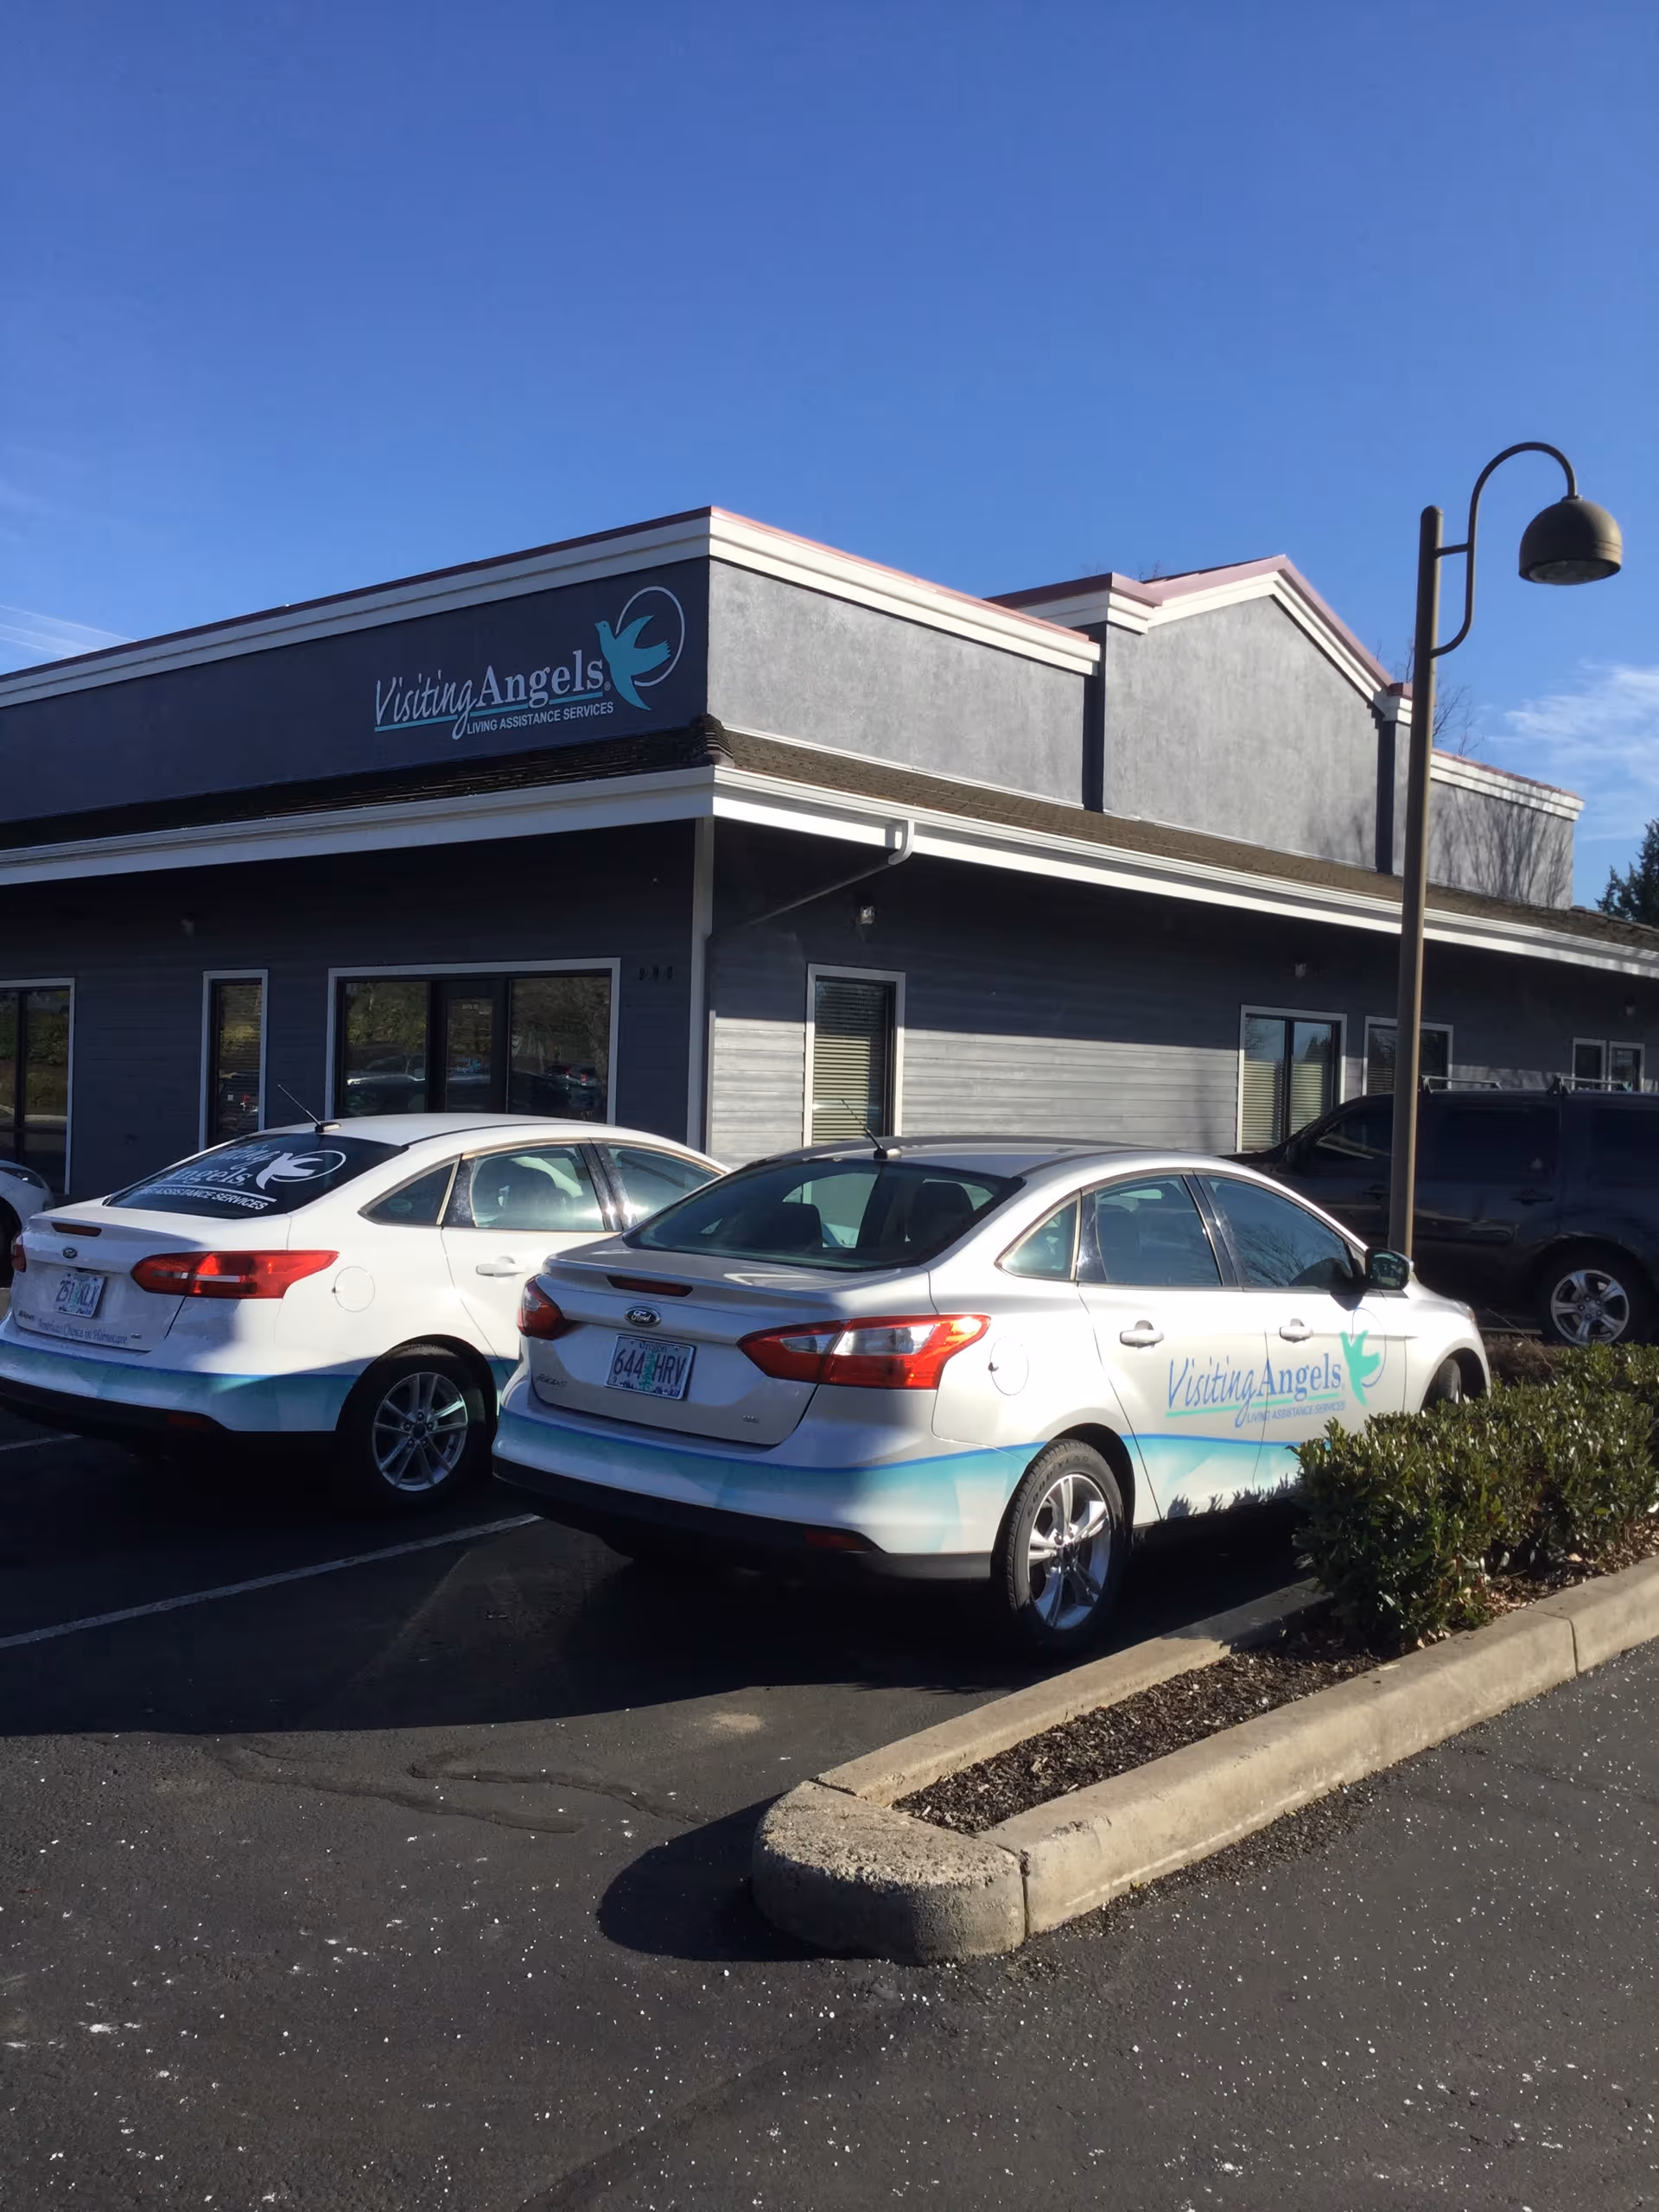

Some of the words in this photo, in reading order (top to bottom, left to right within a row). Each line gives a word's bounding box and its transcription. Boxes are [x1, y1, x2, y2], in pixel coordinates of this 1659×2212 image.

[376, 669, 477, 740] Visiting
[475, 650, 604, 709] Angels
[467, 719, 498, 734] LIVING
[499, 709, 561, 729] ASSISTANCE
[563, 701, 614, 721] SERVICES
[211, 1191, 269, 1210] SERVICES
[639, 1340, 668, 1354] Oregon
[613, 1348, 646, 1380] 644
[652, 1353, 688, 1386] HRV
[1168, 1355, 1257, 1428] Visiting
[1256, 1353, 1342, 1402] Angels
[1247, 1409, 1271, 1423] LIVING
[1272, 1405, 1313, 1420] ASSISTANCE
[1315, 1400, 1346, 1414] SERVICES
